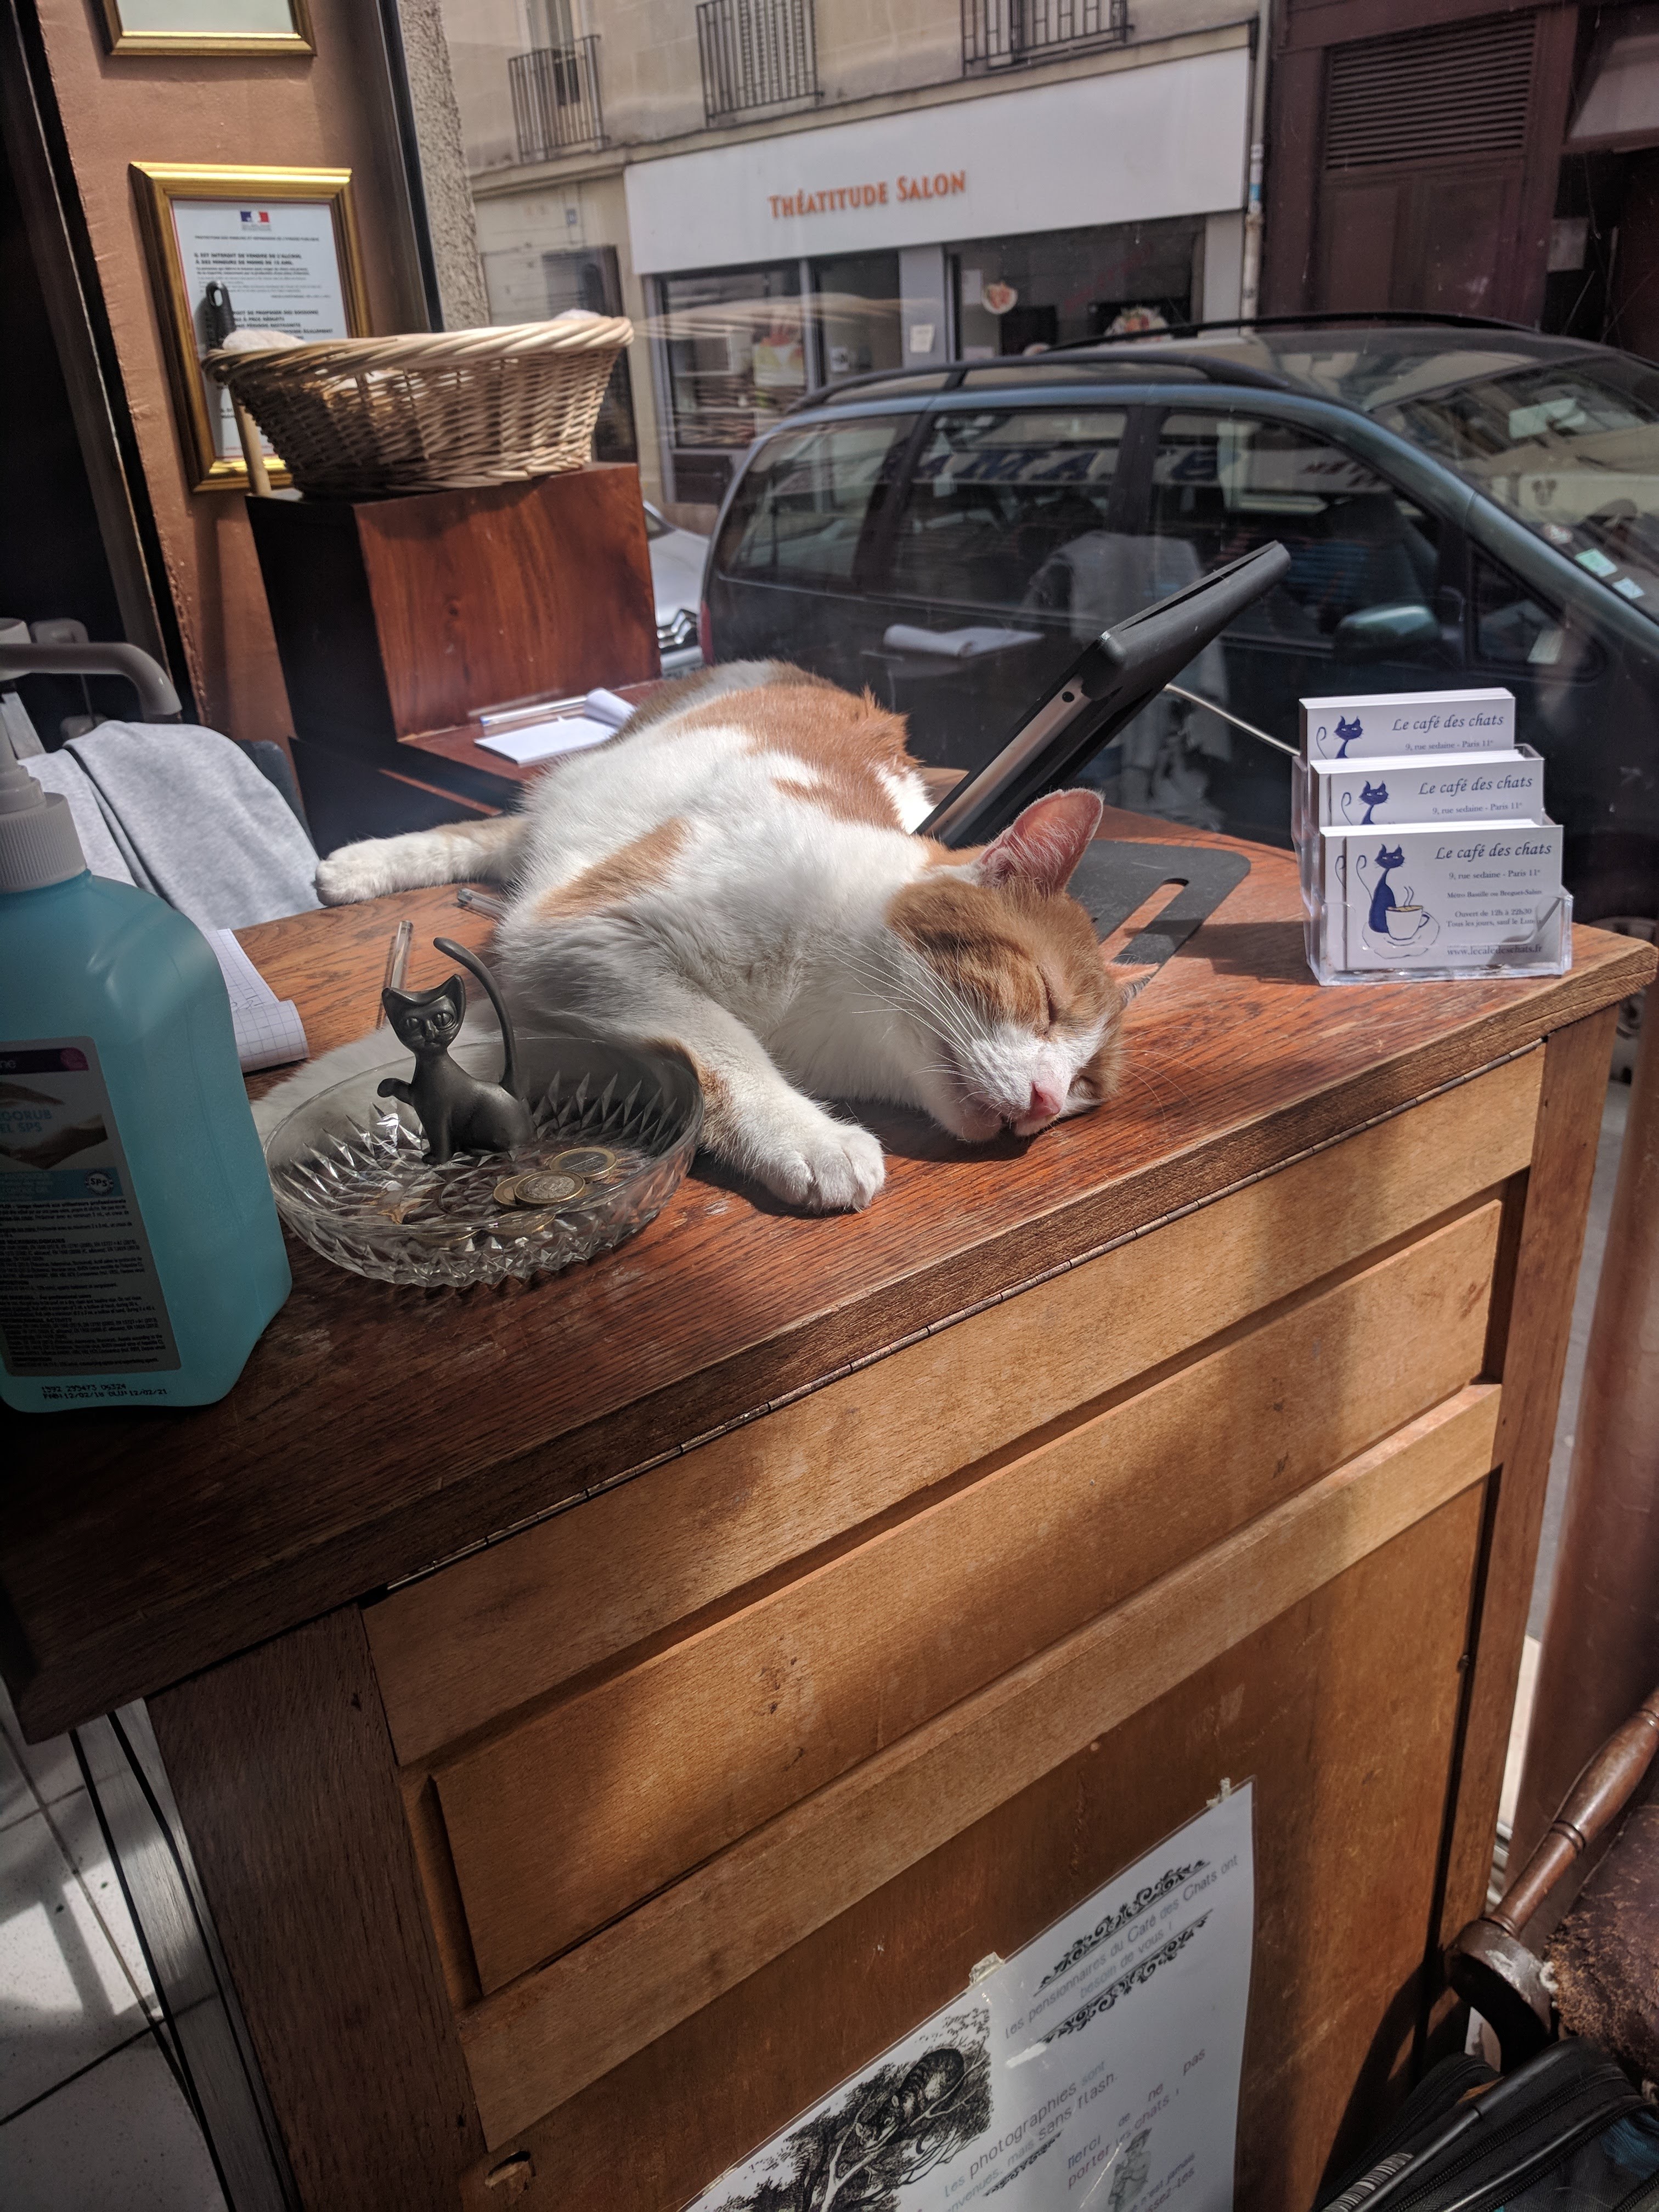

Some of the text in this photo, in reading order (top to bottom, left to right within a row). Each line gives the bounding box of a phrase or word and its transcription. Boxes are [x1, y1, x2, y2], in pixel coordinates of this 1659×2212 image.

[769, 170, 966, 219] THÉATITUDE SALON
[1392, 713, 1504, 733] Le café des chats
[1429, 742, 1455, 750] sedaine
[1418, 775, 1533, 797] Le café des chats
[1455, 805, 1482, 813] sedaine
[1435, 842, 1552, 862] Le café des chats
[89, 1177, 108, 1188] SPS
[1029, 1954, 1107, 2023] pensionnaires
[1110, 1940, 1124, 1957] du
[1128, 1914, 1156, 1942] Café
[1160, 1898, 1179, 1920] des
[1183, 1870, 1217, 1901] Chats
[1221, 1854, 1238, 1875] ont
[1080, 1965, 1116, 1999] besoin
[1120, 1951, 1134, 1968] de
[1138, 1929, 1164, 1953] vous
[1148, 2083, 1163, 2102] ne
[1183, 2049, 1205, 2076] pas
[969, 2082, 1076, 2180] photographies
[1081, 2061, 1105, 2086] sont
[1007, 2140, 1035, 2167] mais
[1039, 2107, 1072, 2141] sans
[1068, 2143, 1111, 2190] porter
